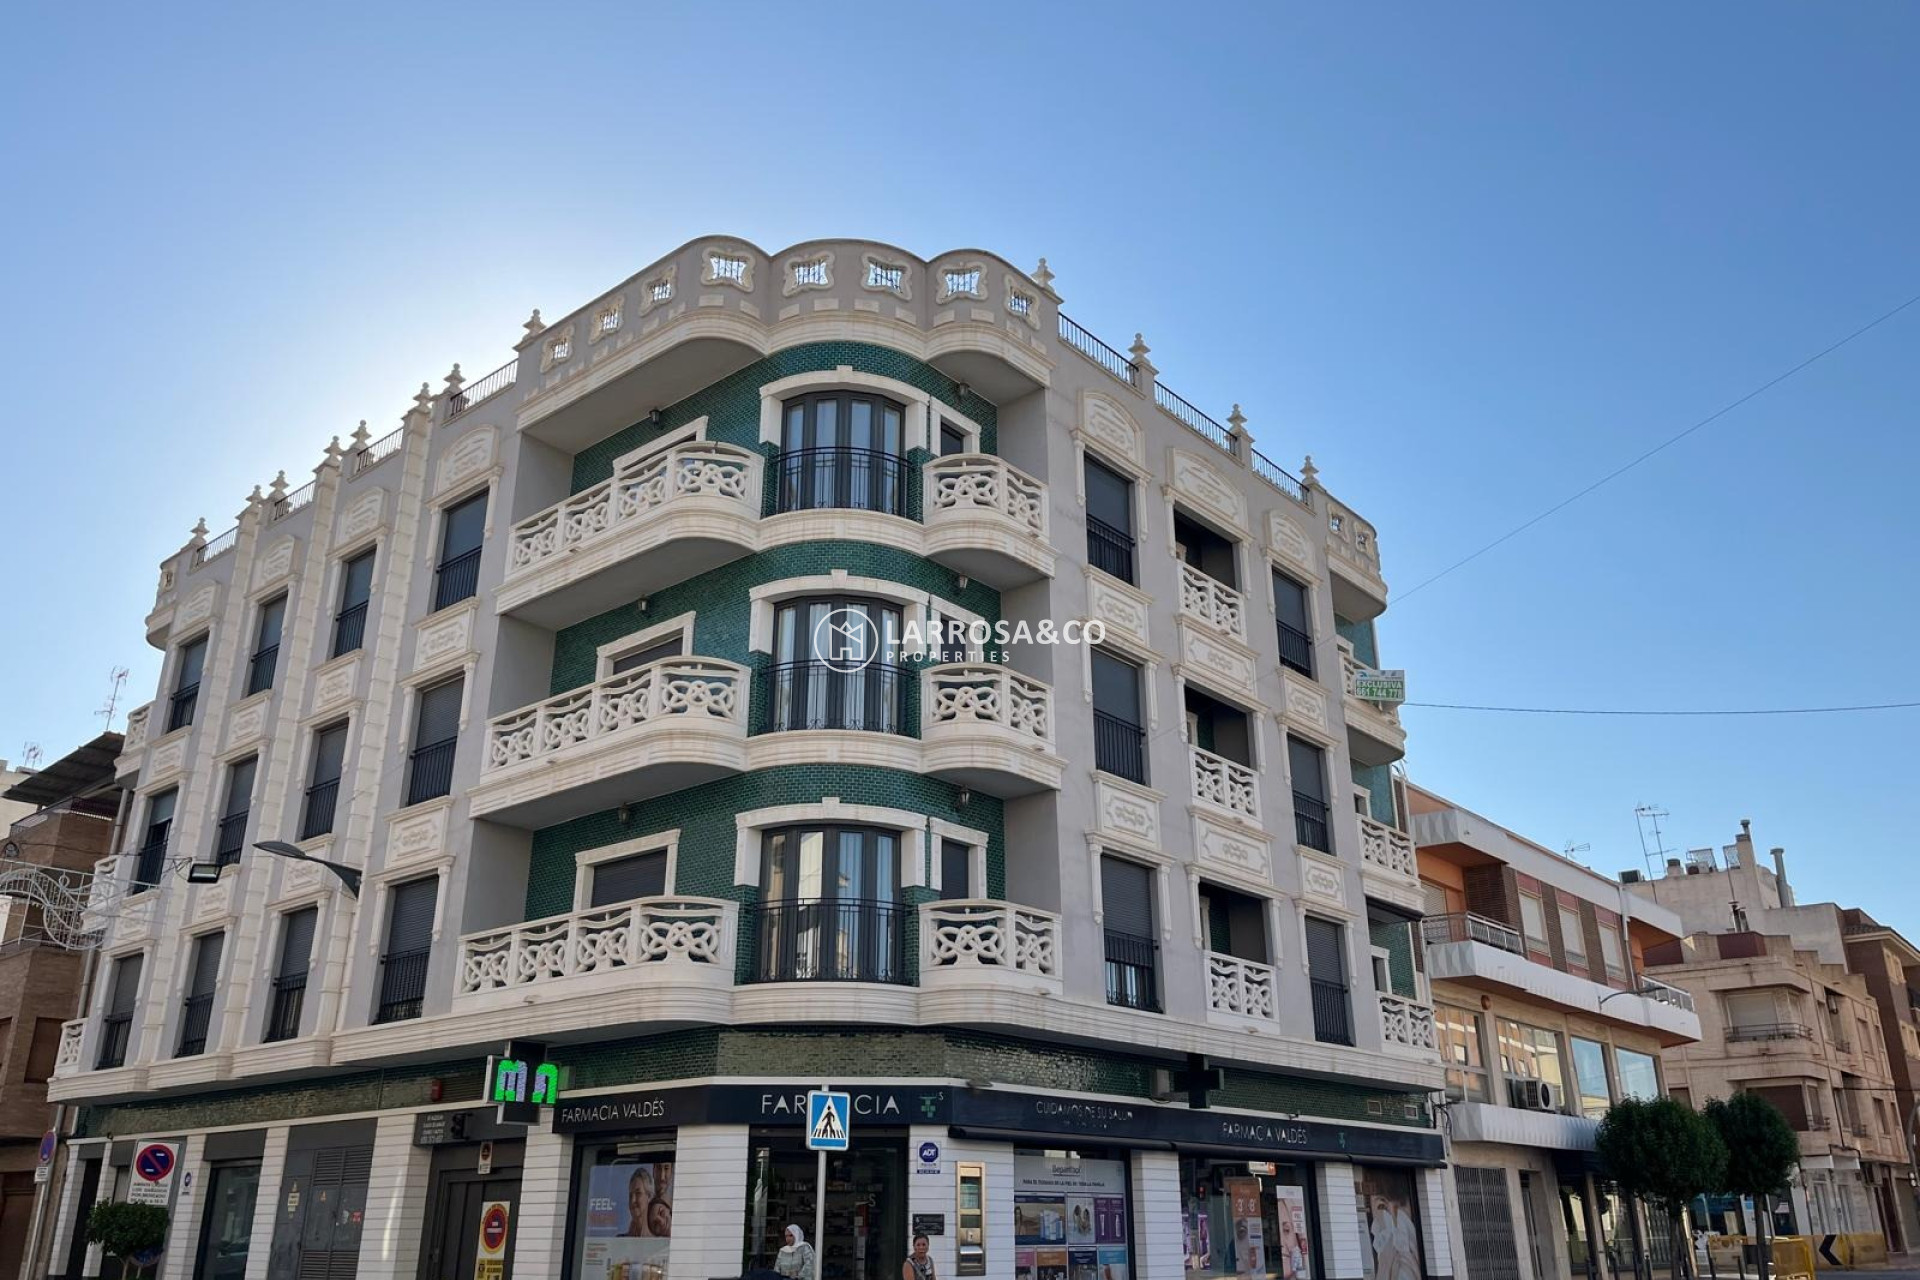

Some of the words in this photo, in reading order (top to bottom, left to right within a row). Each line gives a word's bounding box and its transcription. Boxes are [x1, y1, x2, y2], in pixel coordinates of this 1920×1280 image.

[561, 1105, 619, 1123] FARMACIA
[623, 1097, 665, 1118] VALDÉS
[761, 1094, 900, 1115] FARCIA
[1222, 1122, 1273, 1142] FARMACA
[1275, 1127, 1308, 1145] VALDÉS
[922, 1148, 936, 1157] ADT
[589, 1197, 613, 1211] FEEL
